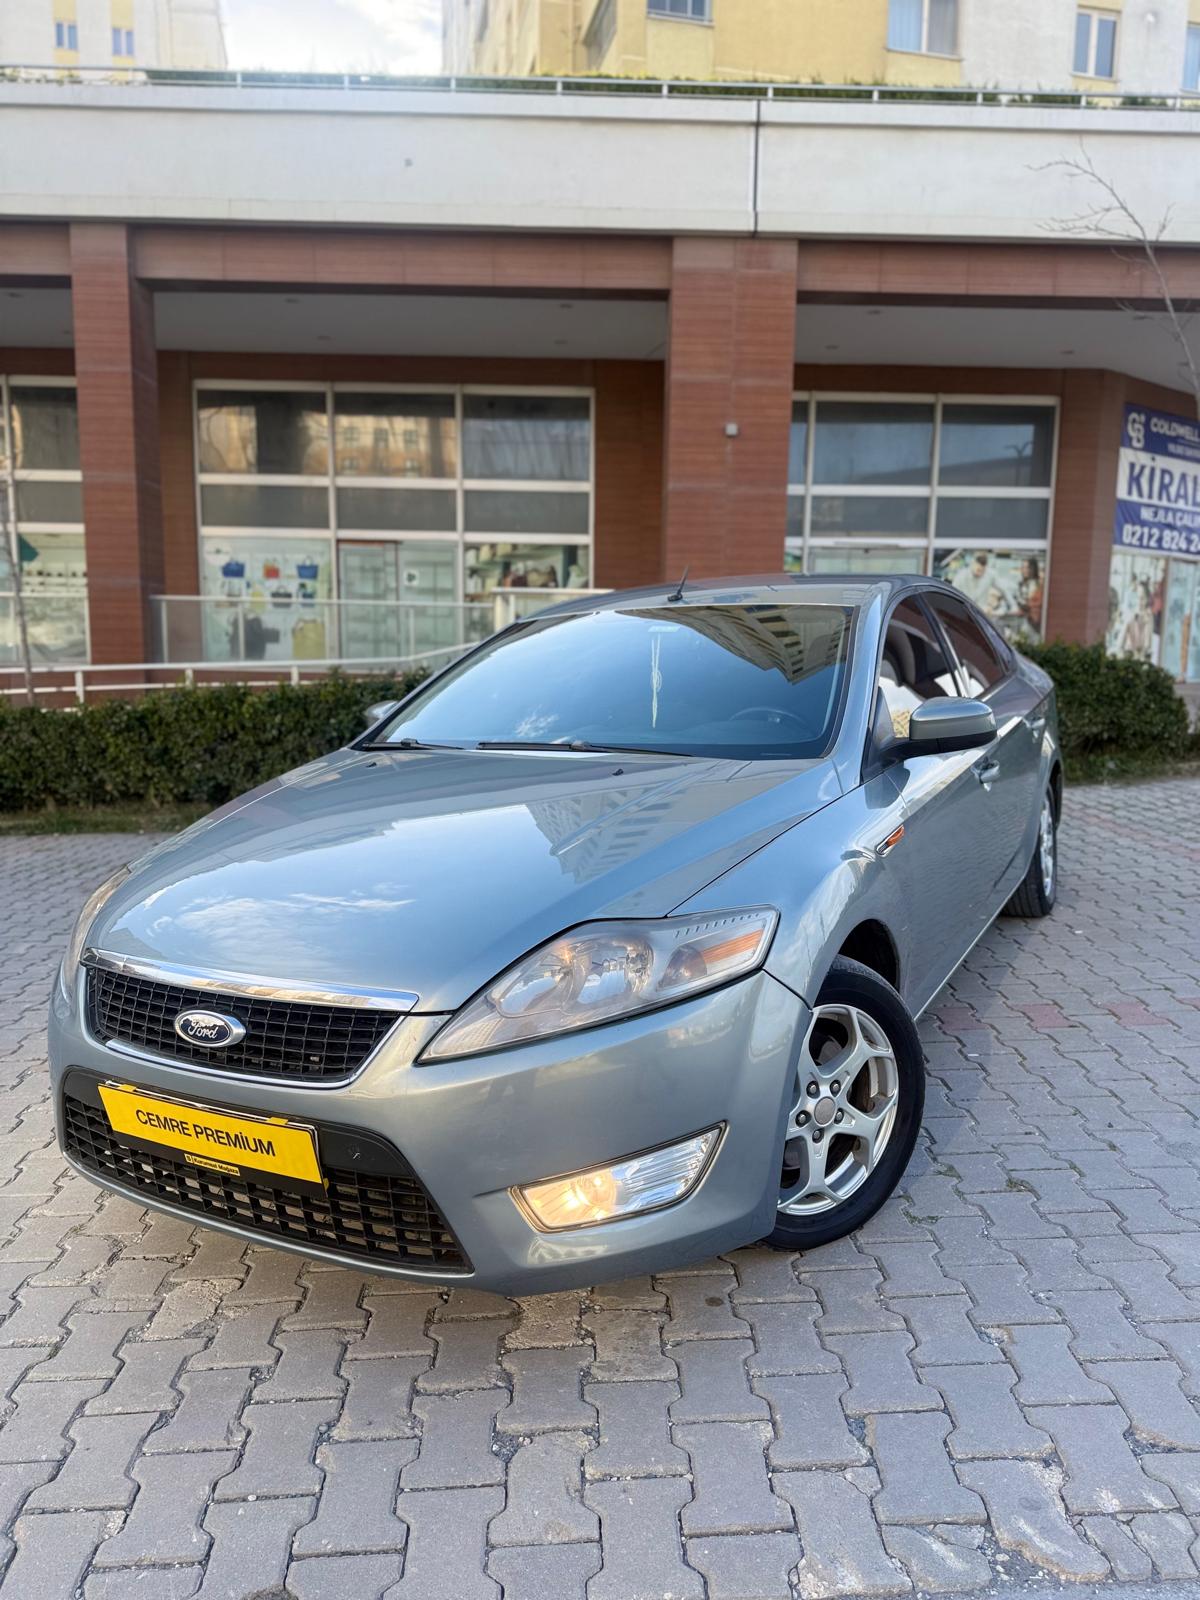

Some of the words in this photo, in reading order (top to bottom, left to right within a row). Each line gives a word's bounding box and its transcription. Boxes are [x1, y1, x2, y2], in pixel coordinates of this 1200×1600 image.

[1122, 523, 1160, 548] 0212
[1162, 528, 1188, 551] 824
[187, 1018, 219, 1039] Ford
[135, 1109, 192, 1137] CEMRE
[194, 1124, 276, 1157] PREMİUM
